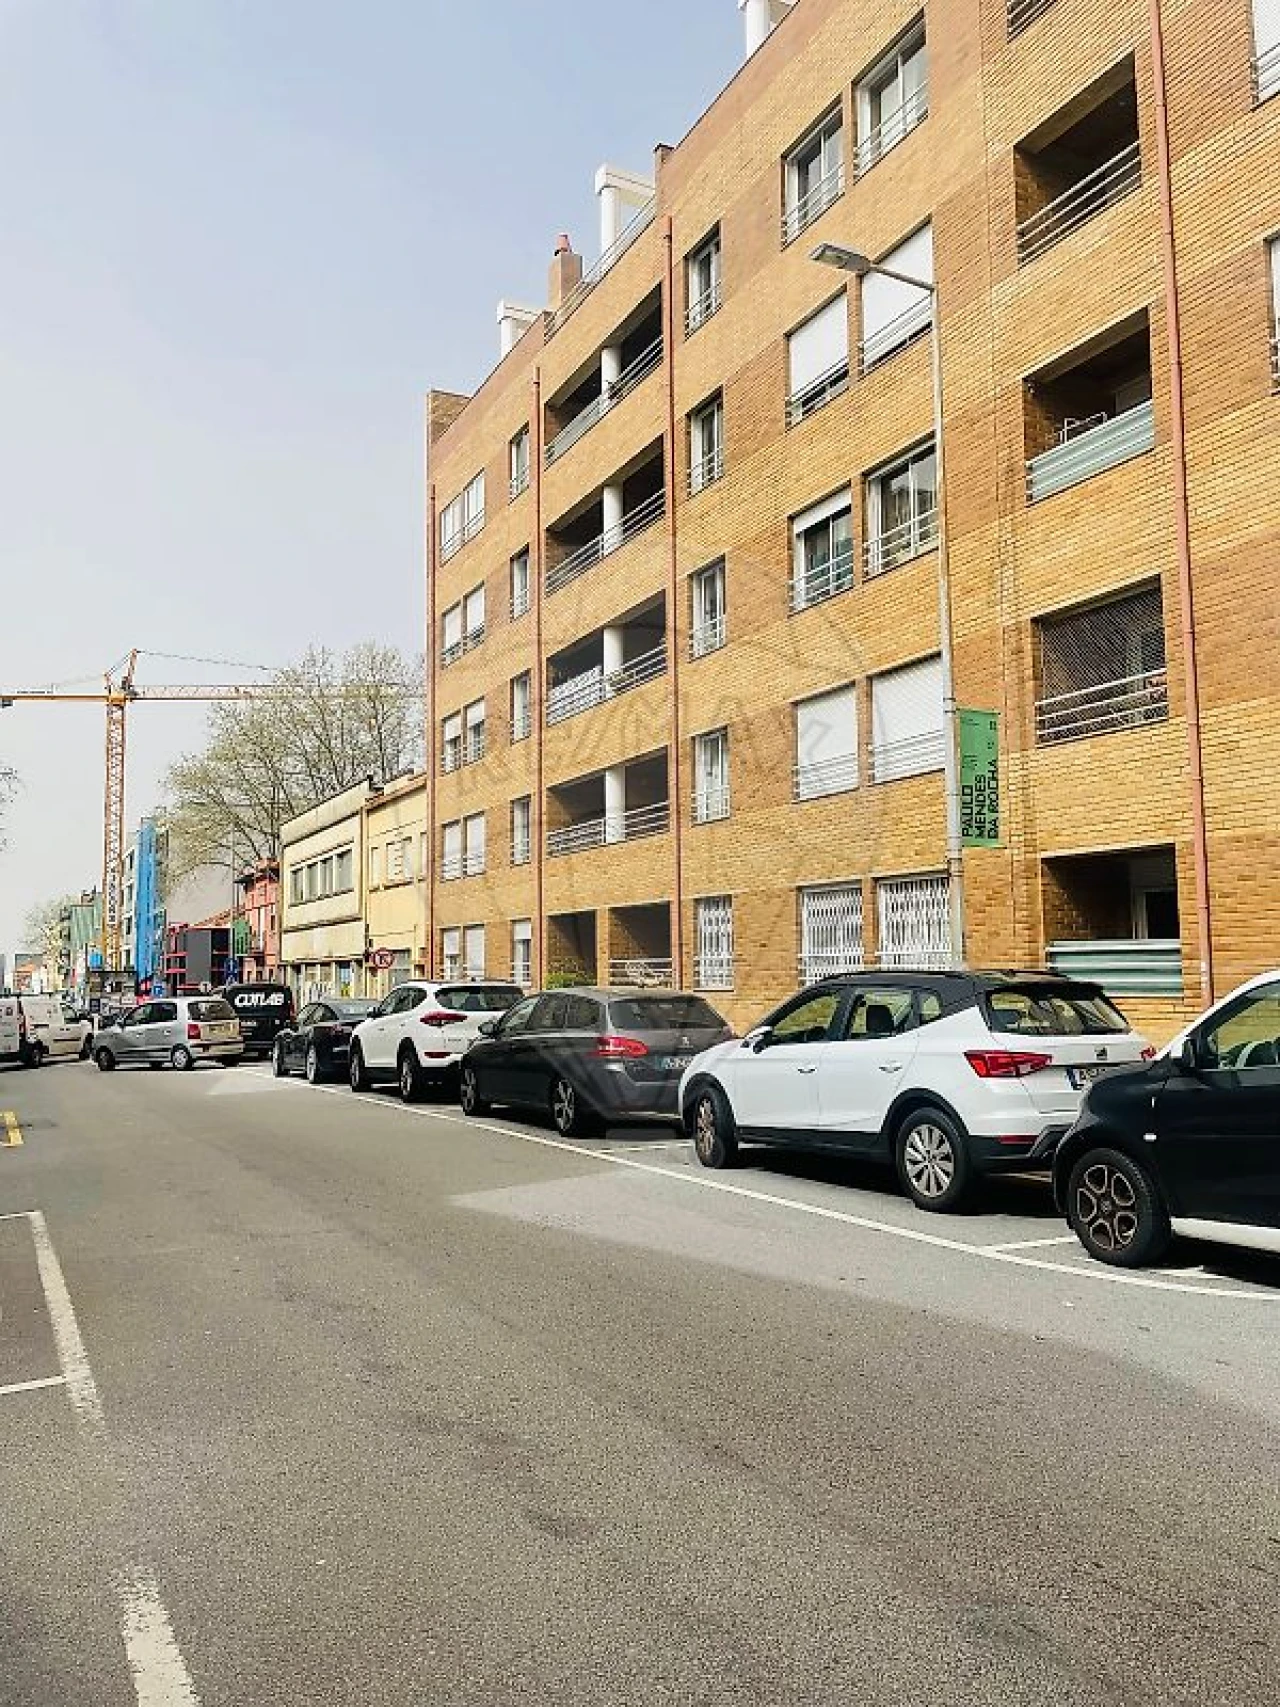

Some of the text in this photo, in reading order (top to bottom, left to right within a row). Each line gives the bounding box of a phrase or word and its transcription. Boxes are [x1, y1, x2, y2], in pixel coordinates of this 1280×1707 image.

[962, 785, 974, 837] PAULO
[975, 773, 986, 839] MENDES
[987, 758, 999, 814] ROCHA
[987, 816, 999, 839] DA
